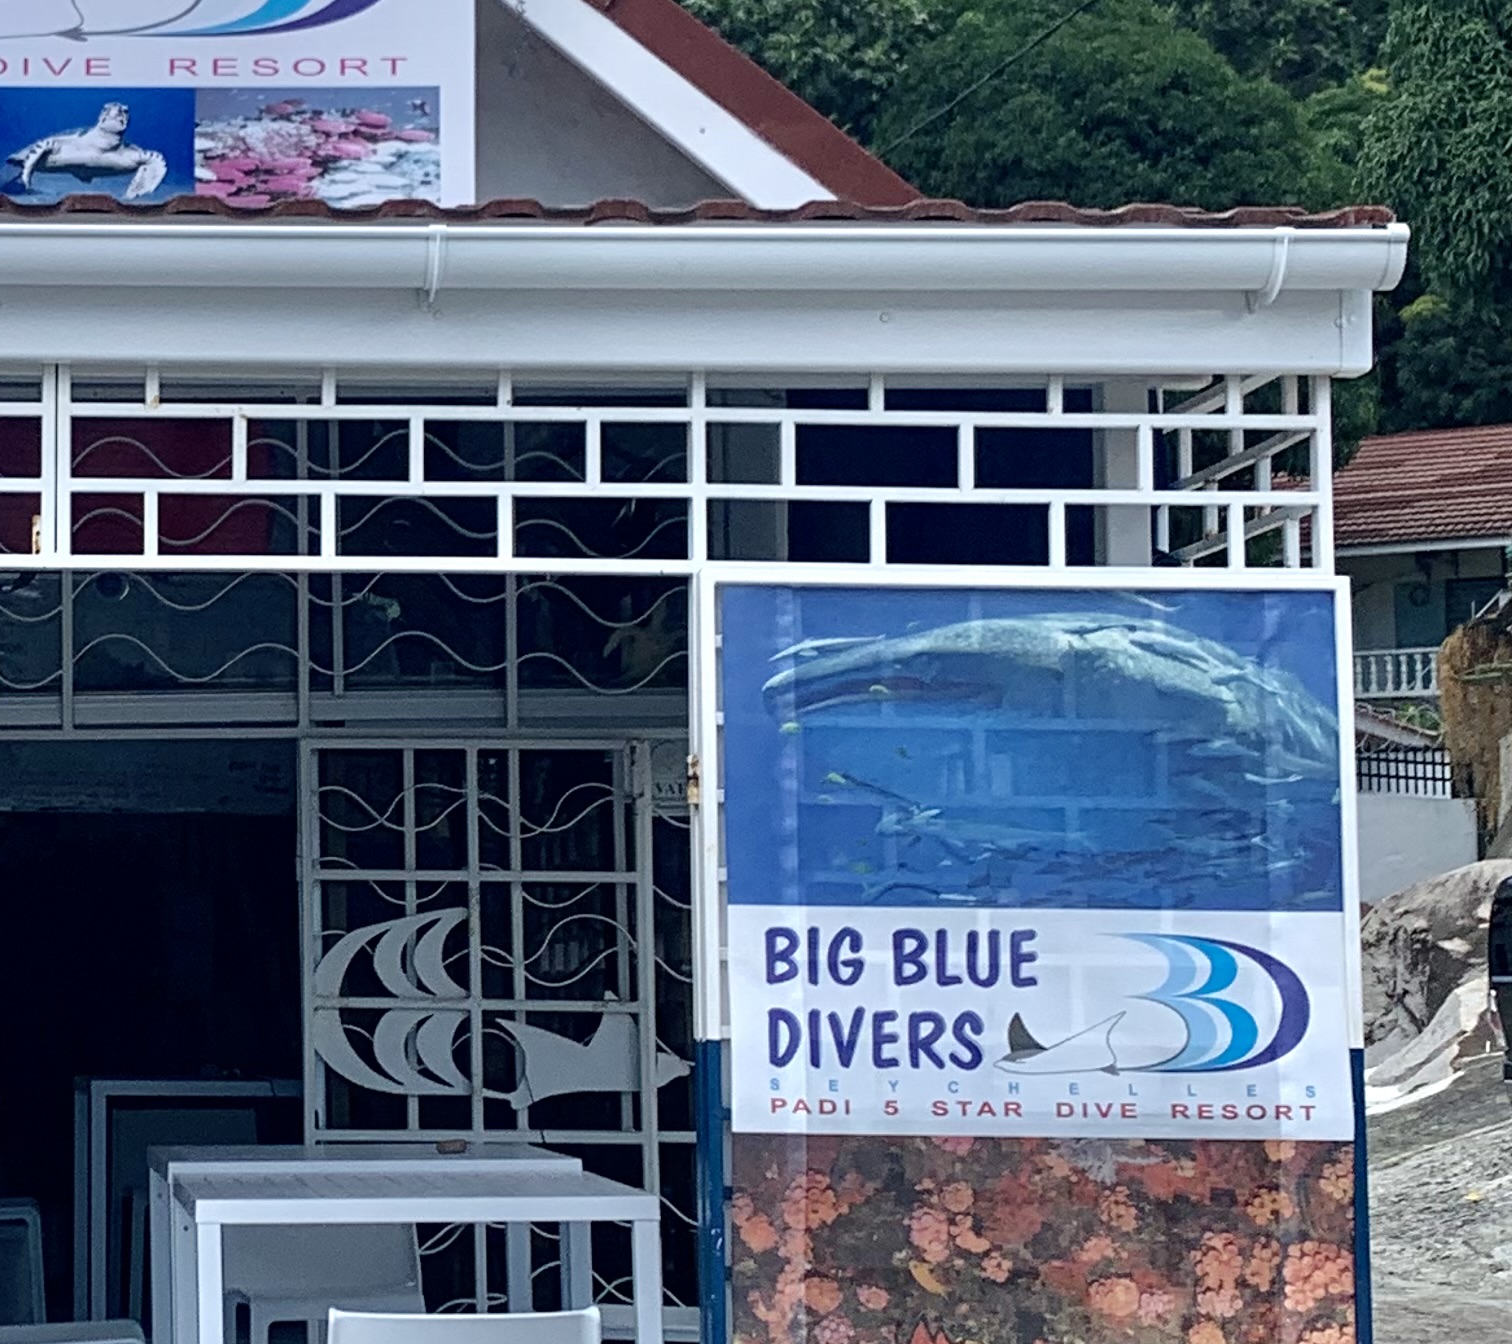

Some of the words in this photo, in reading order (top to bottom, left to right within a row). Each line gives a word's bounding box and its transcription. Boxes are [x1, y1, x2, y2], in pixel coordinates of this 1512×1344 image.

[169, 57, 407, 77] RESORT
[765, 926, 864, 986] BIG
[892, 928, 1038, 988] BLUE
[767, 1005, 985, 1071] DIVERS
[769, 1077, 1317, 1098] SEYCHELLES
[769, 1097, 851, 1116] PADI
[884, 1099, 899, 1116] 5
[931, 1100, 1023, 1118] STAR
[1056, 1102, 1137, 1119] DIVE
[1171, 1103, 1317, 1121] RESORT
